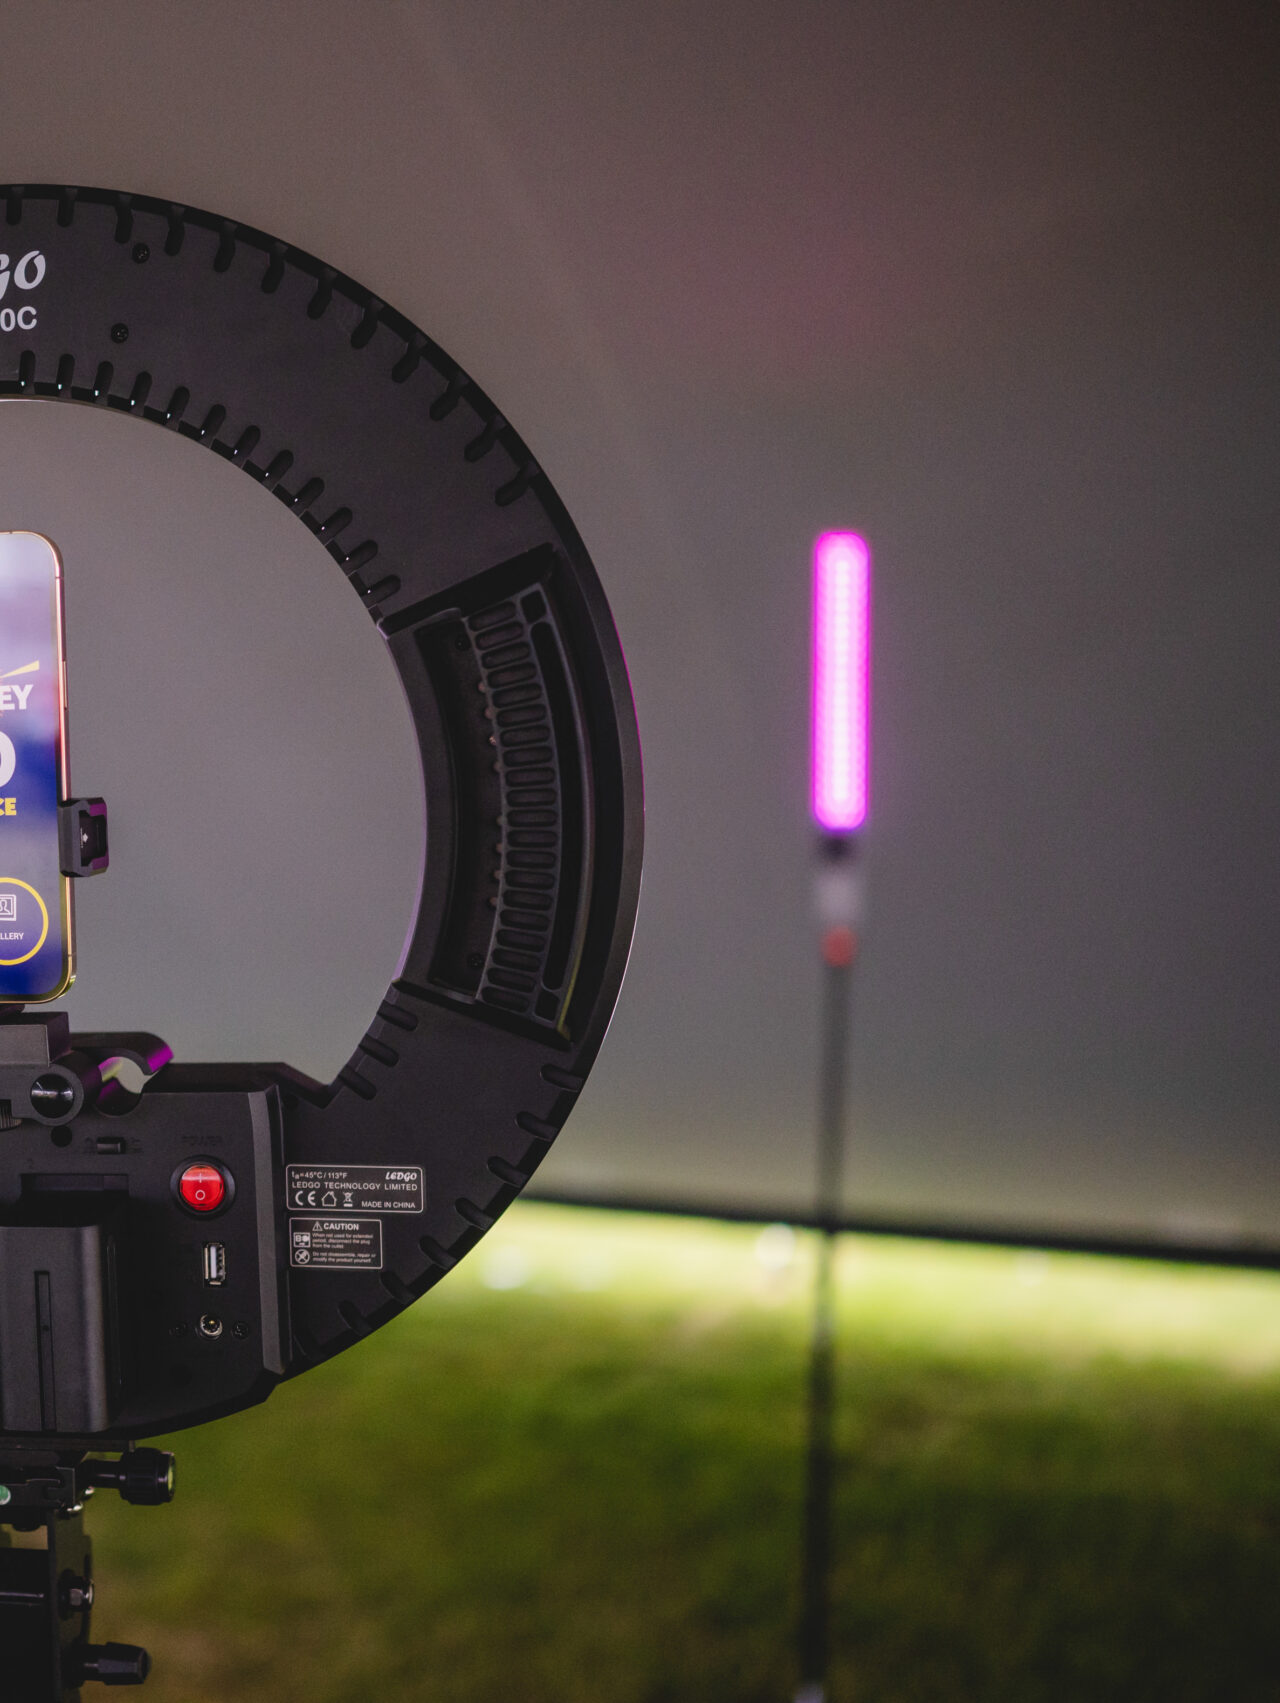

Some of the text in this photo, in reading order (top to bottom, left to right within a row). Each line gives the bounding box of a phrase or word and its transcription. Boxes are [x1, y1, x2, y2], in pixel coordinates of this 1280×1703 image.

[385, 1172, 417, 1182] LEDGO
[292, 1181, 320, 1189] LEDGO
[324, 1182, 381, 1190] TECHNOLOGY
[393, 1201, 416, 1209] CHINA
[323, 1222, 359, 1231] CAUTION
